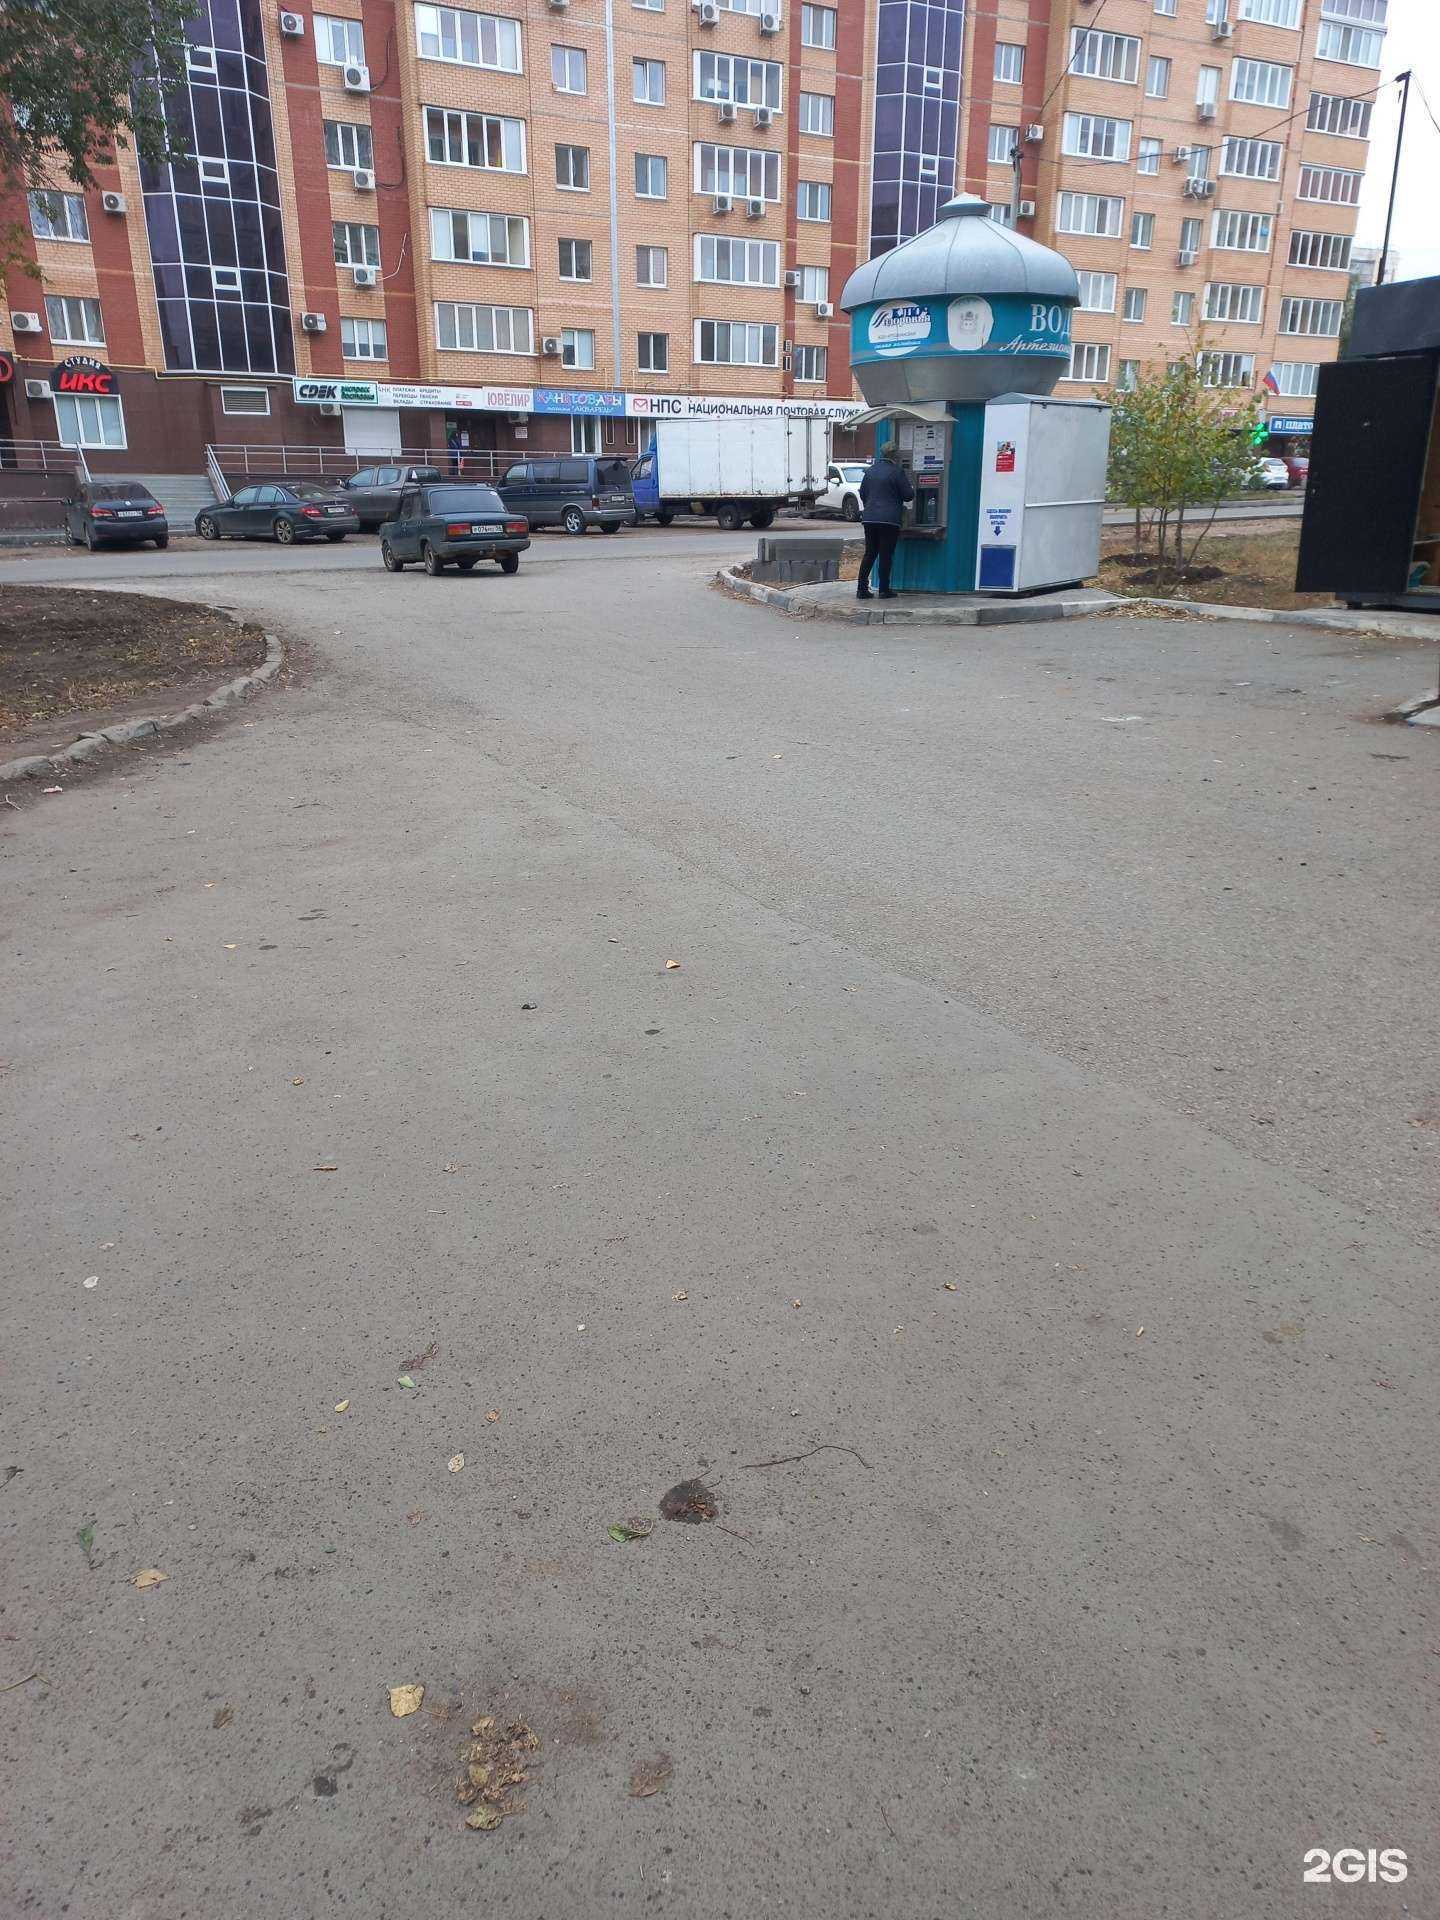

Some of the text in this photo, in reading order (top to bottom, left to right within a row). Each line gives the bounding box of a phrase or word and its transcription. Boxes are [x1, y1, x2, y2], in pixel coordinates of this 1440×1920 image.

[64, 356, 101, 369] СТУДИЯ
[59, 373, 112, 393] ИКС
[299, 384, 338, 399] CDEK
[487, 391, 530, 408] ЮВЕЛИР
[650, 398, 682, 414] НПС
[688, 403, 773, 415] НАЦИОНАЛЬНАЯ
[775, 406, 826, 417] ПОЧТОВАЯ
